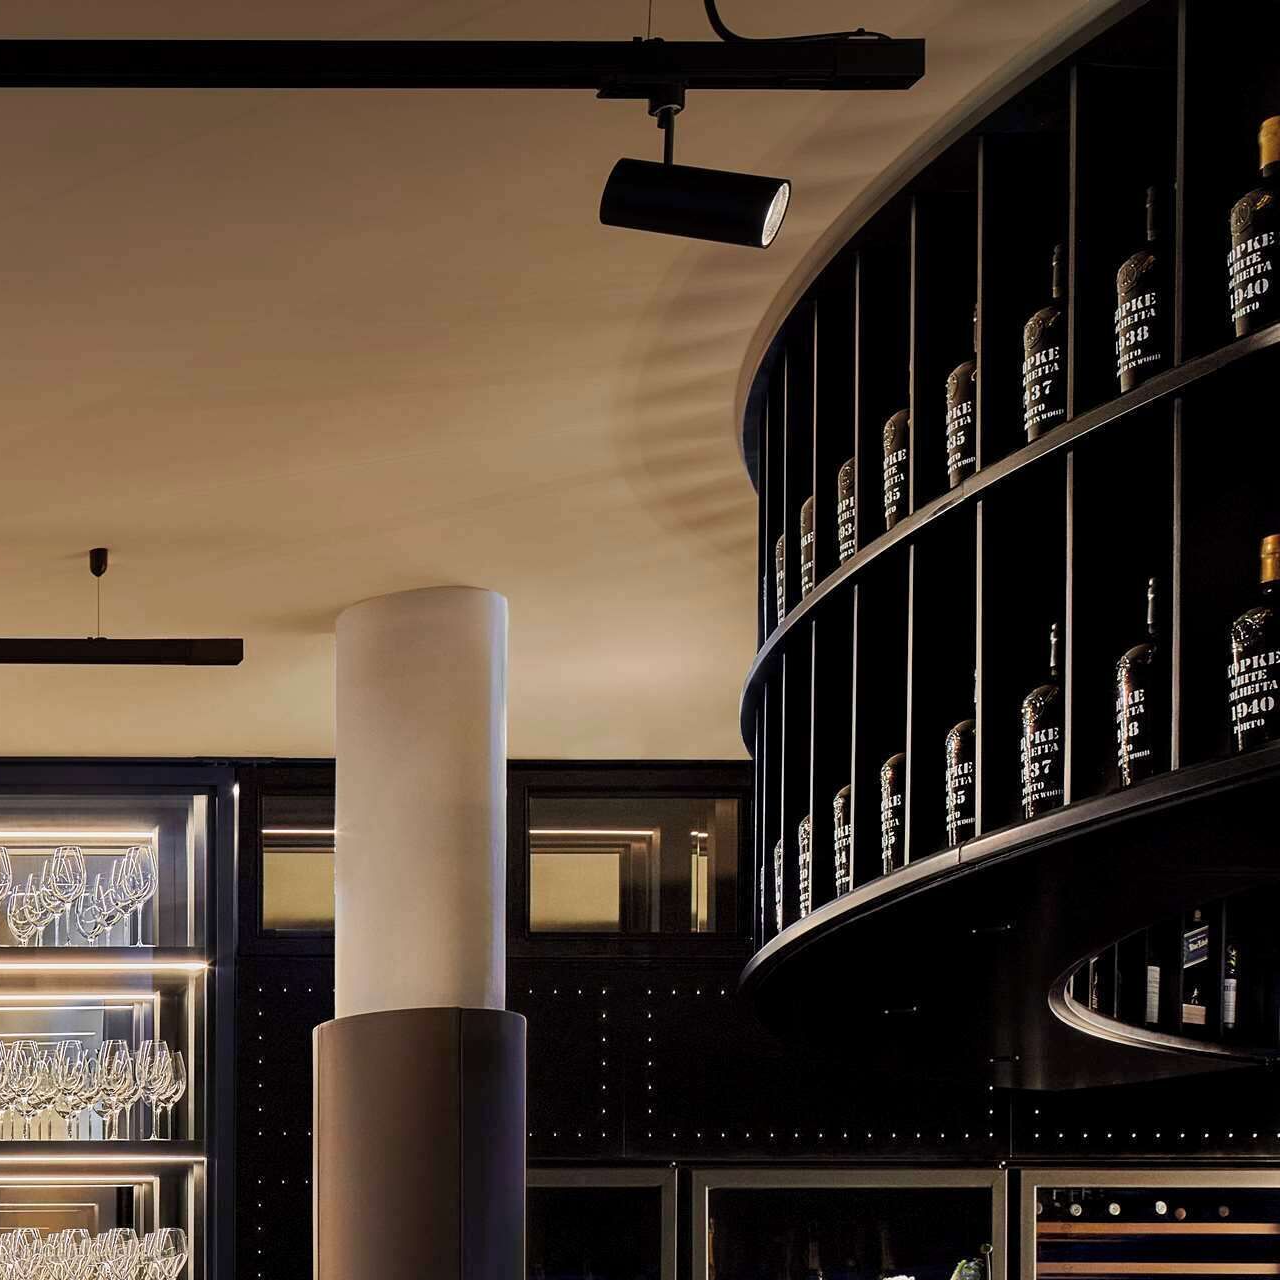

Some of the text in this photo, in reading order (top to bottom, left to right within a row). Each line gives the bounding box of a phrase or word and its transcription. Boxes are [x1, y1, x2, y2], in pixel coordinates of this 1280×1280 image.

[1230, 279, 1269, 310] 1940
[1023, 347, 1059, 374] OPKE
[946, 401, 971, 425] PKE
[1232, 696, 1274, 721] 1940
